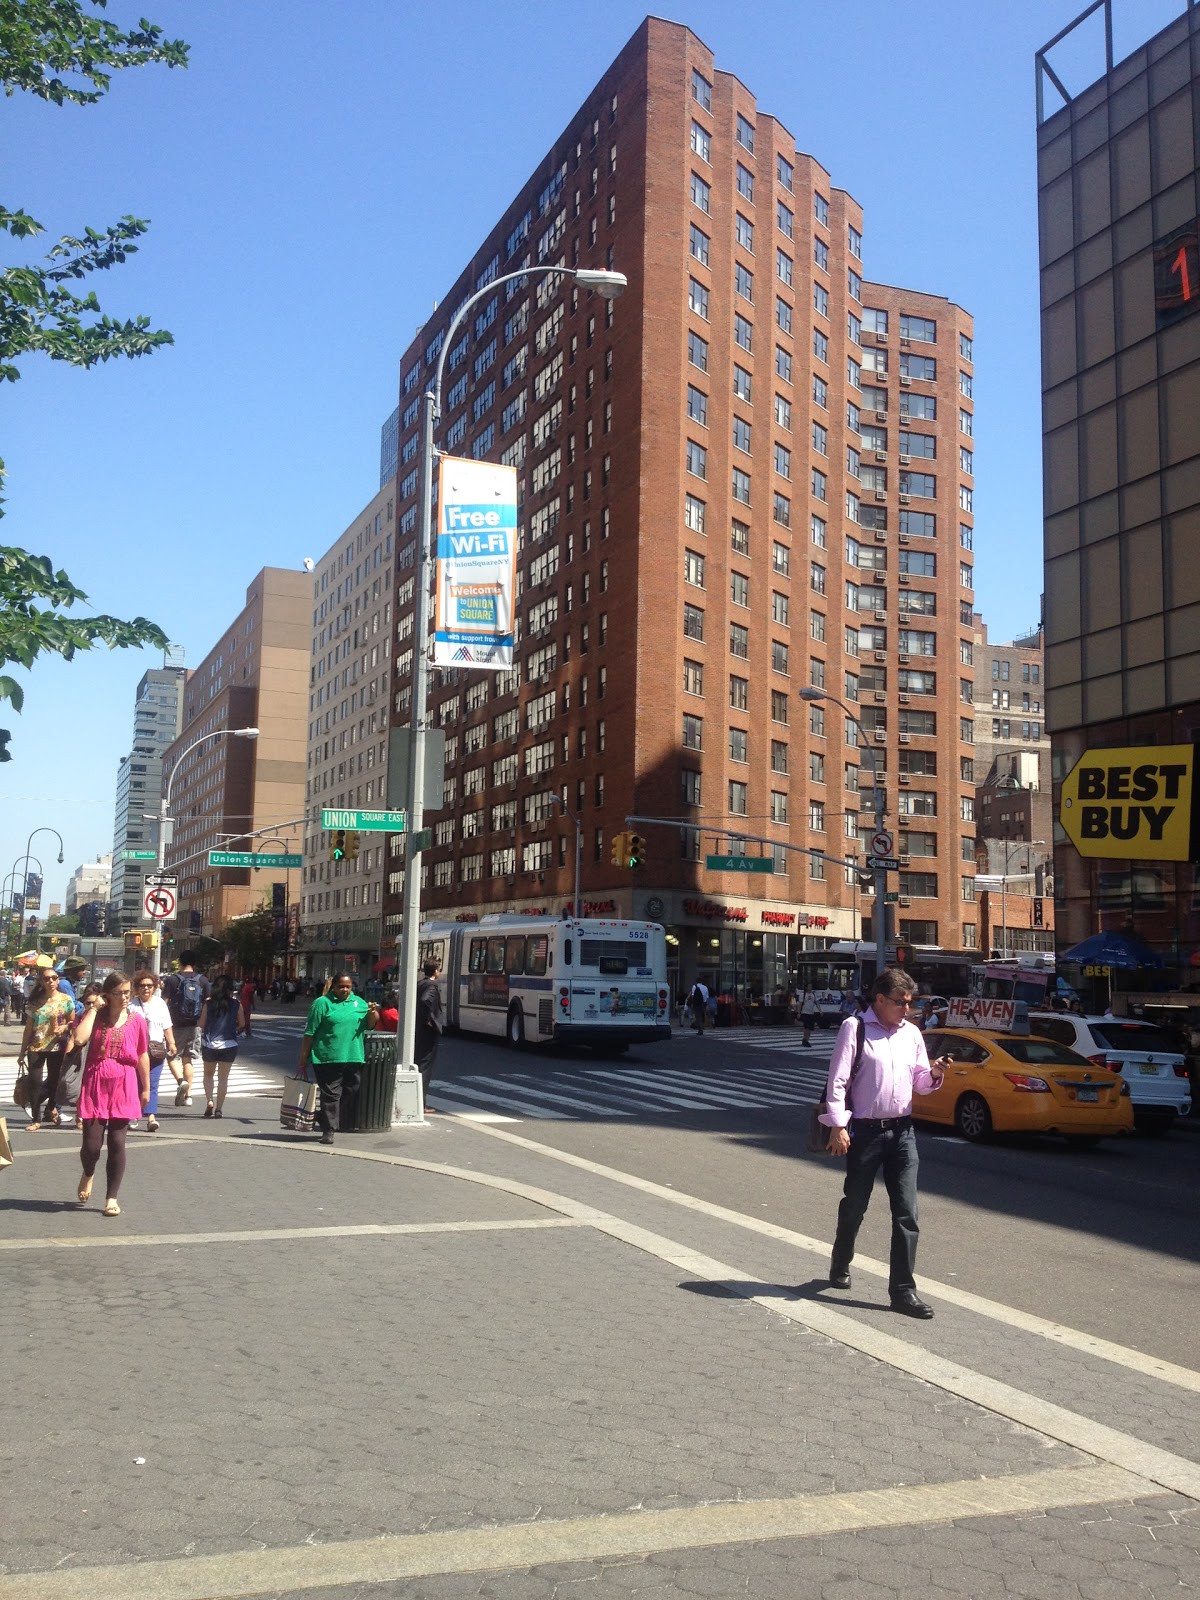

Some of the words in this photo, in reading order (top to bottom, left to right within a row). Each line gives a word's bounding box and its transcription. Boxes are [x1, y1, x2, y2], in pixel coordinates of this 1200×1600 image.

[1171, 247, 1190, 301] 1
[448, 507, 500, 528] Free
[450, 534, 505, 554] Wi-Fi
[446, 558, 508, 568] @nionSquareNY
[451, 586, 501, 595] Welcome
[466, 598, 494, 609] UNION
[460, 608, 494, 620] SQUARE
[1077, 764, 1187, 802] BEST
[324, 811, 357, 828] UNION
[361, 812, 386, 822] SQUARE
[388, 813, 404, 823] EAST
[1080, 806, 1176, 840] BUY
[213, 855, 241, 863] Union
[243, 856, 277, 865] Square
[278, 857, 299, 865] East
[726, 858, 734, 869] 4
[738, 860, 754, 870] Av
[762, 911, 796, 924] PHARMACY
[629, 931, 649, 939] 5528
[949, 998, 1014, 1019] HEAVEN
[960, 1016, 997, 1025] BRODWAY
